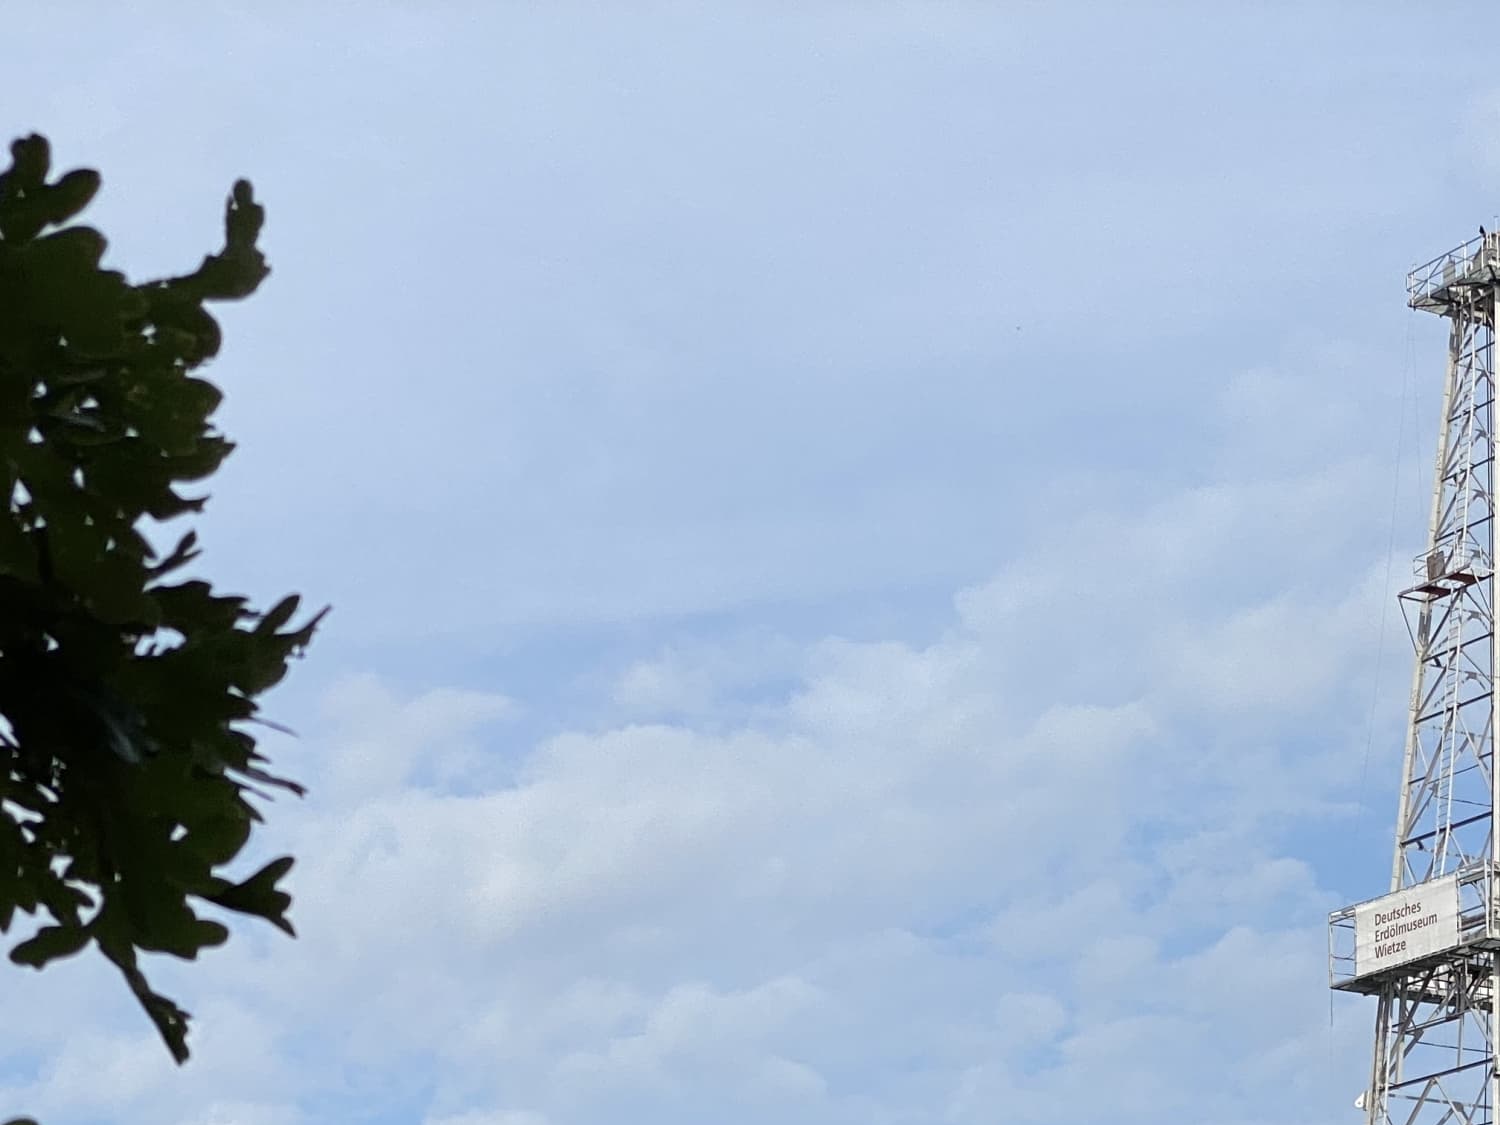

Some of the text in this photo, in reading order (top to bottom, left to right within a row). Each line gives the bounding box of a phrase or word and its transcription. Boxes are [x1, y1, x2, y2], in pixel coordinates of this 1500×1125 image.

[1375, 902, 1421, 926] Deutsches
[1375, 914, 1437, 942] Erdölmuseum
[1375, 940, 1406, 958] Wietze
